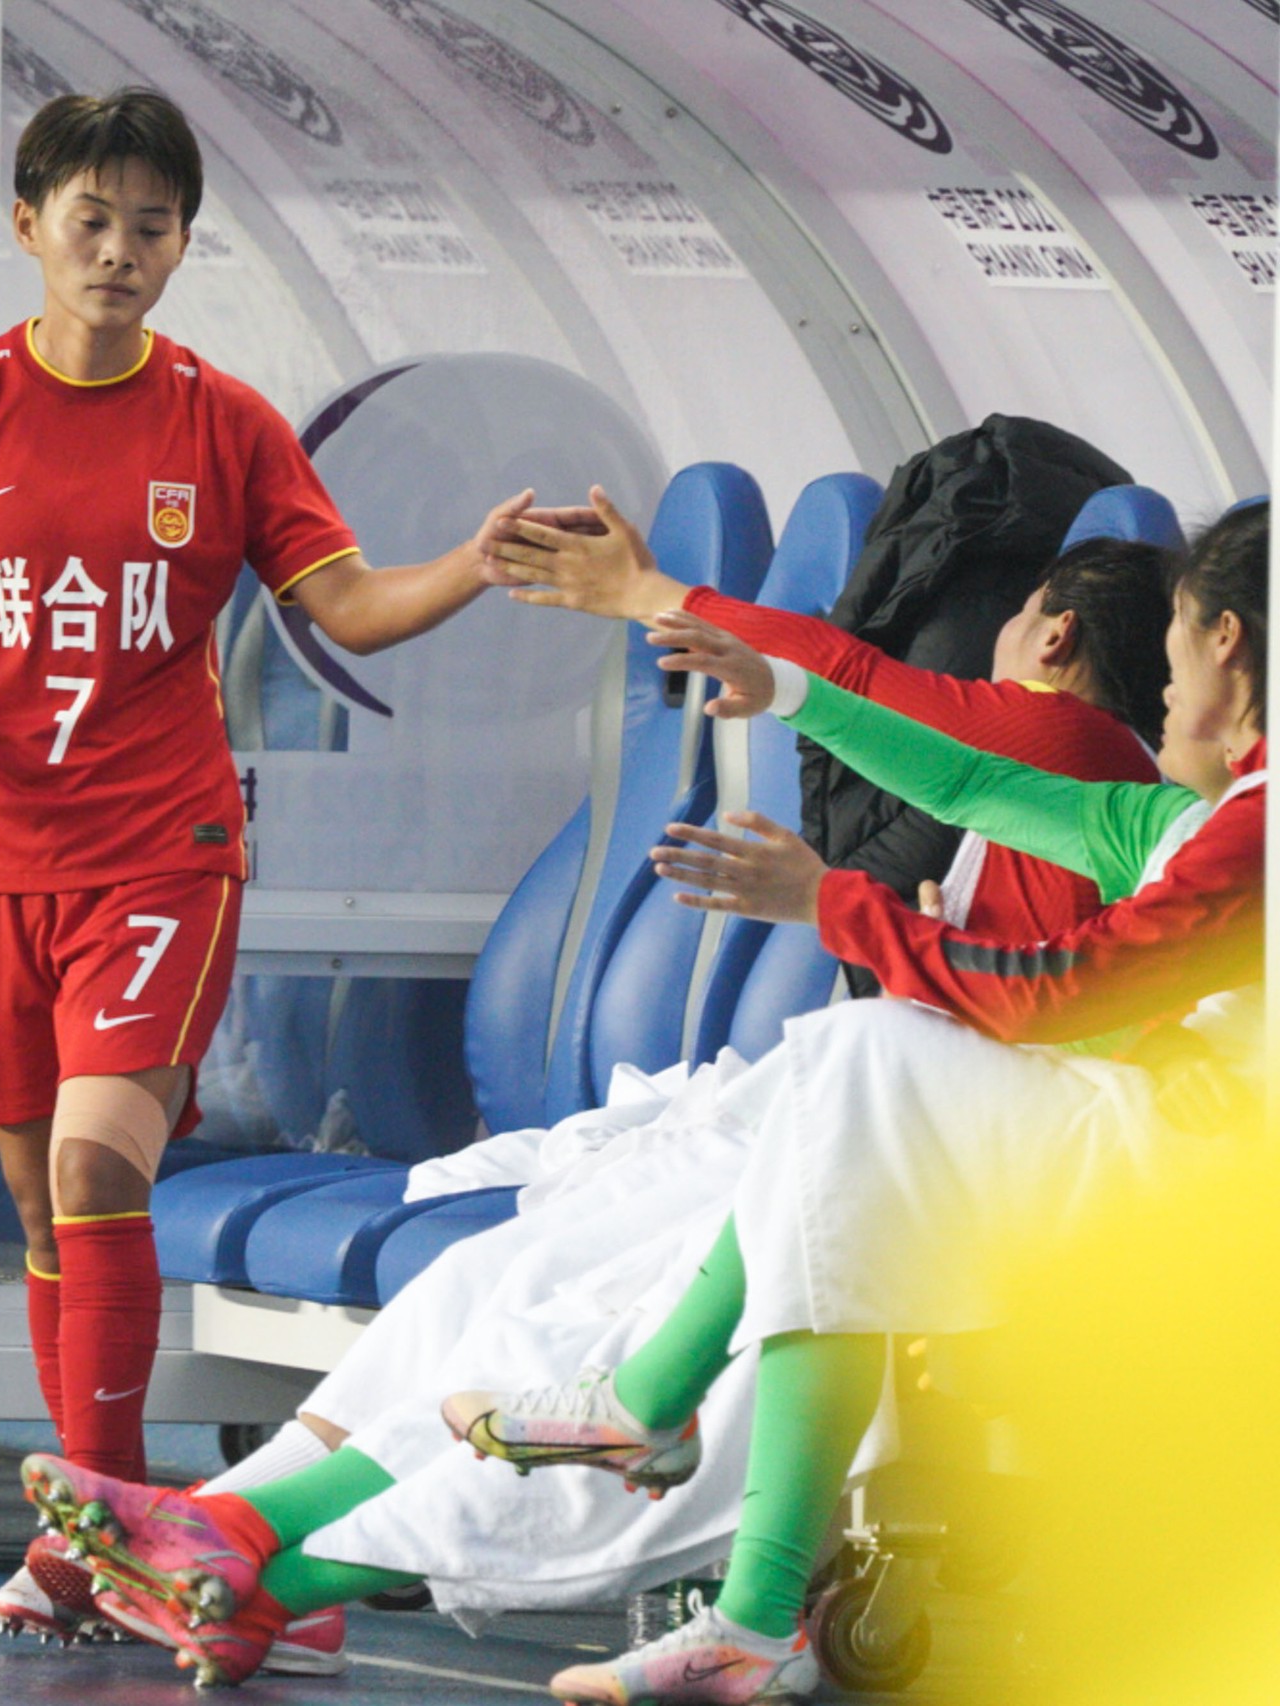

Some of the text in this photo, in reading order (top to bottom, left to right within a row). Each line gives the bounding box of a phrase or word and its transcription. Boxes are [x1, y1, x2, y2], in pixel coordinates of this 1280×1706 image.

[967, 243, 1102, 279] SHAANXI CHINA
[156, 488, 189, 501] CFA
[46, 675, 96, 764] 7
[122, 914, 180, 1001] 7
